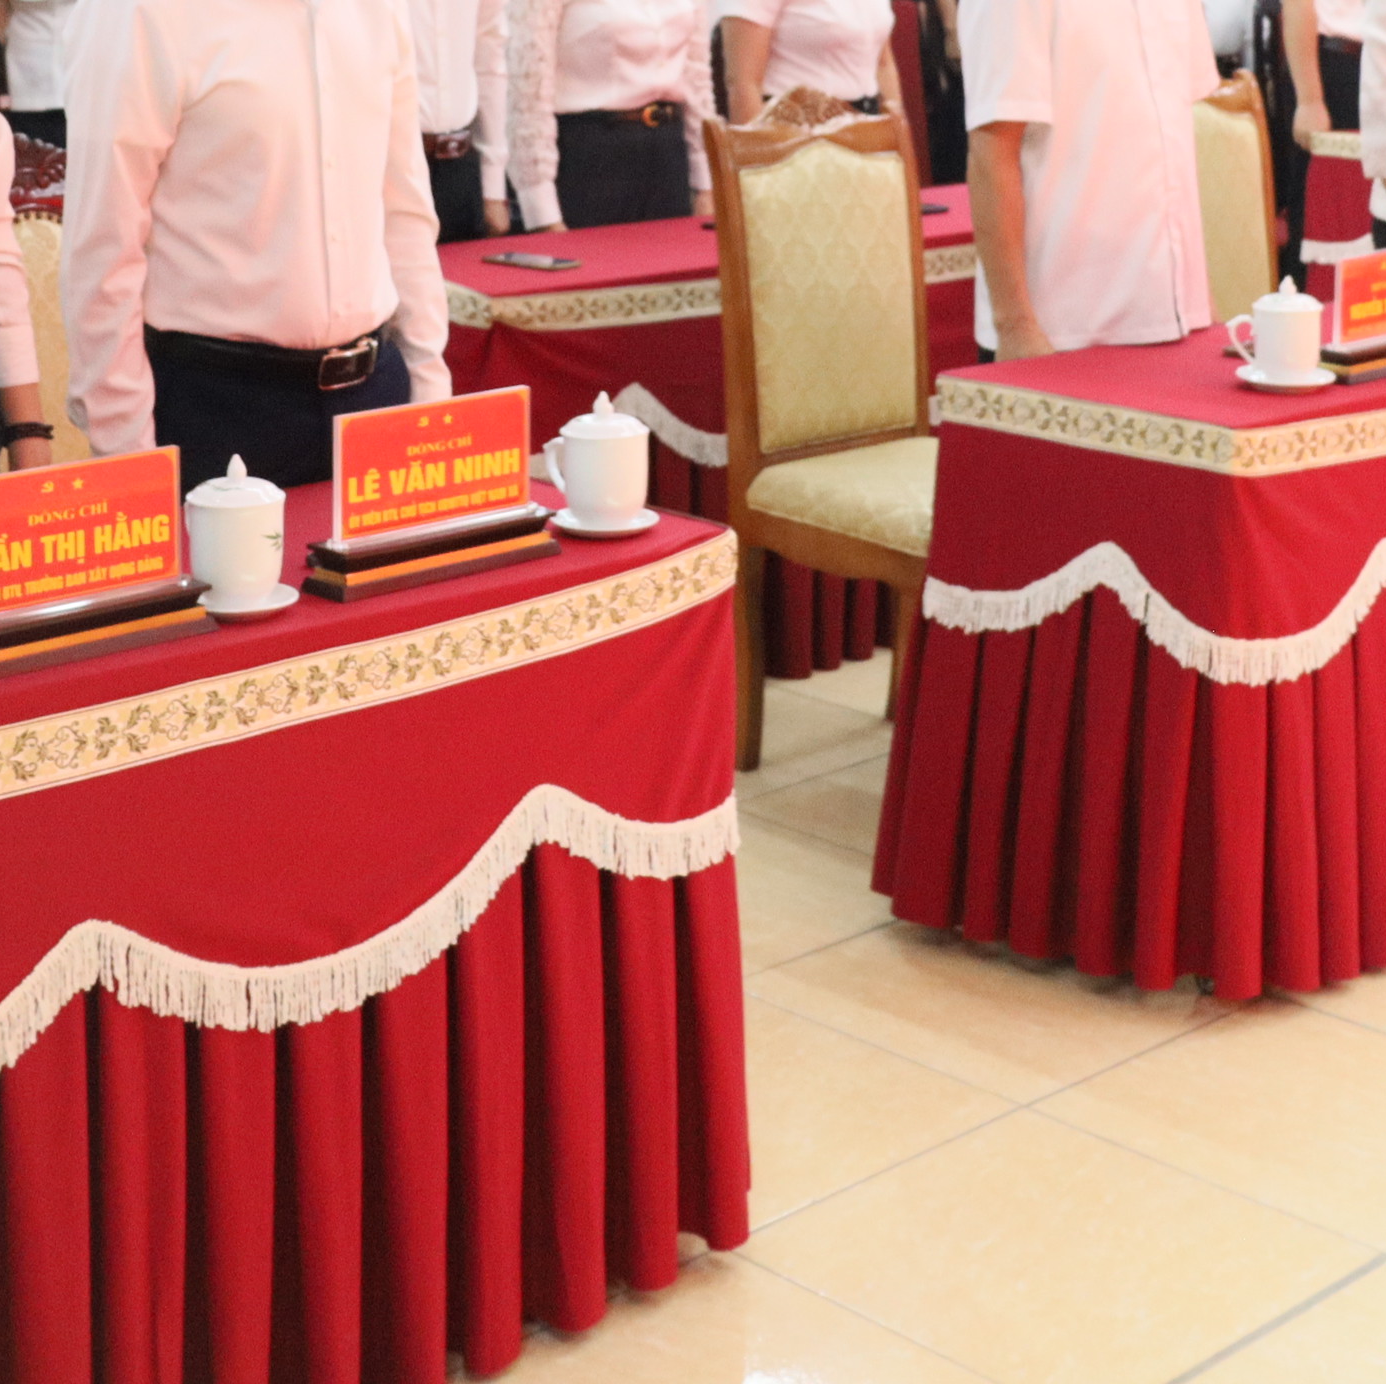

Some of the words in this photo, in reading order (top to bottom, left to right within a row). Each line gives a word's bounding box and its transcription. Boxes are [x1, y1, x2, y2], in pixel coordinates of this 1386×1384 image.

[348, 468, 381, 504] LÊ
[389, 460, 446, 496] VĂN
[453, 447, 521, 484] NINH
[40, 529, 85, 564] THỊ
[94, 511, 171, 555] HẰNG
